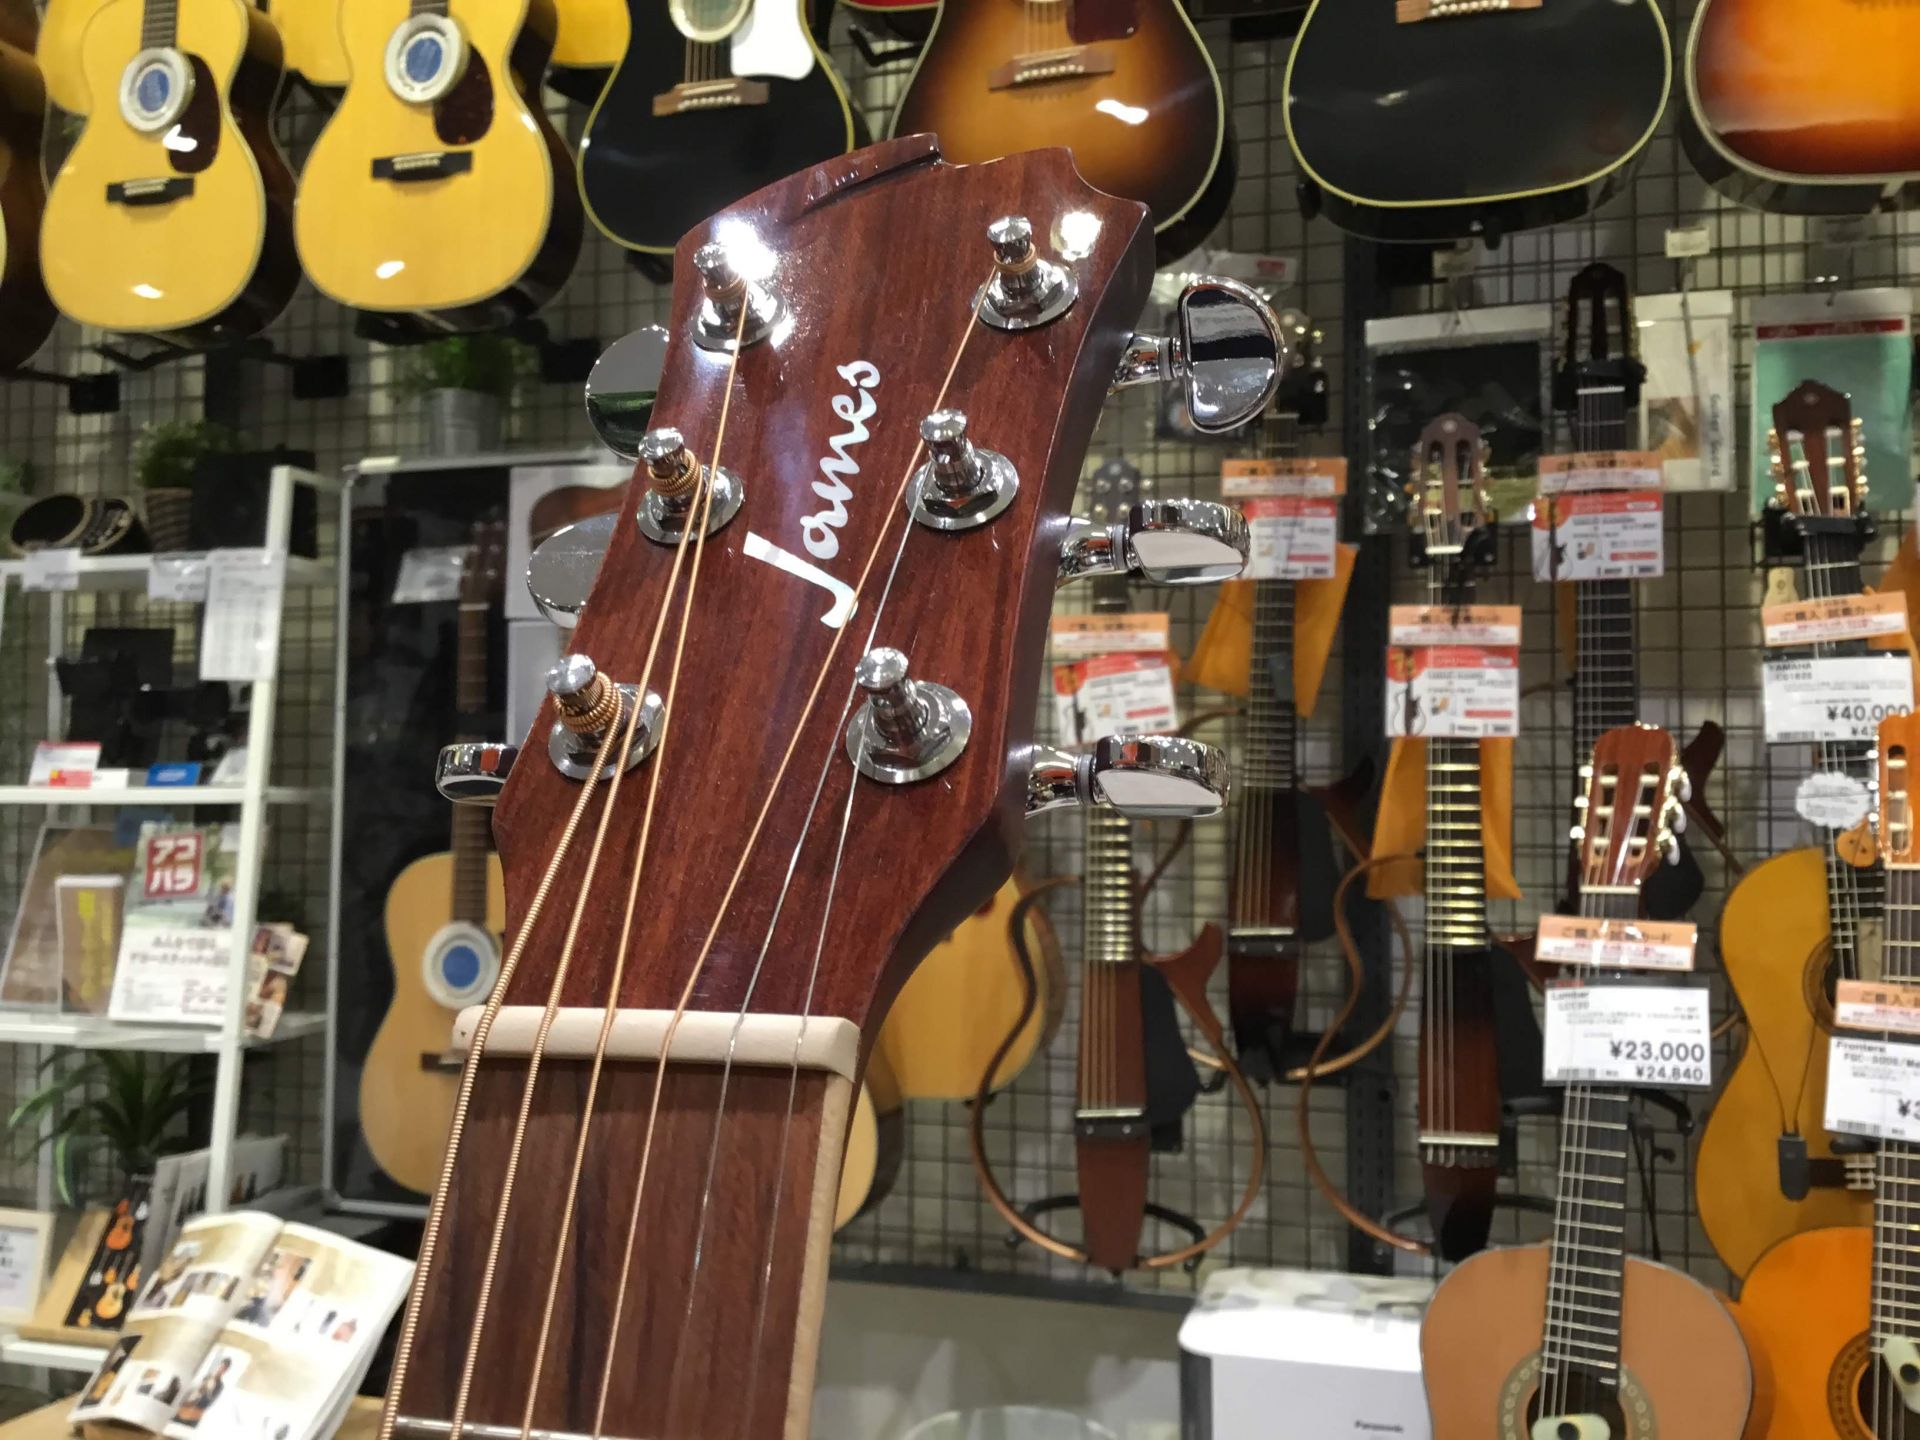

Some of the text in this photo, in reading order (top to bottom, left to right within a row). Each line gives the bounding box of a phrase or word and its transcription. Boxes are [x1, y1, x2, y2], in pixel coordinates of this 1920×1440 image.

[743, 360, 881, 629] James
[1769, 662, 1812, 672] YAMAHA
[1610, 1040, 1705, 1063] ¥23,000
[1636, 1065, 1704, 1082] ¥24,840
